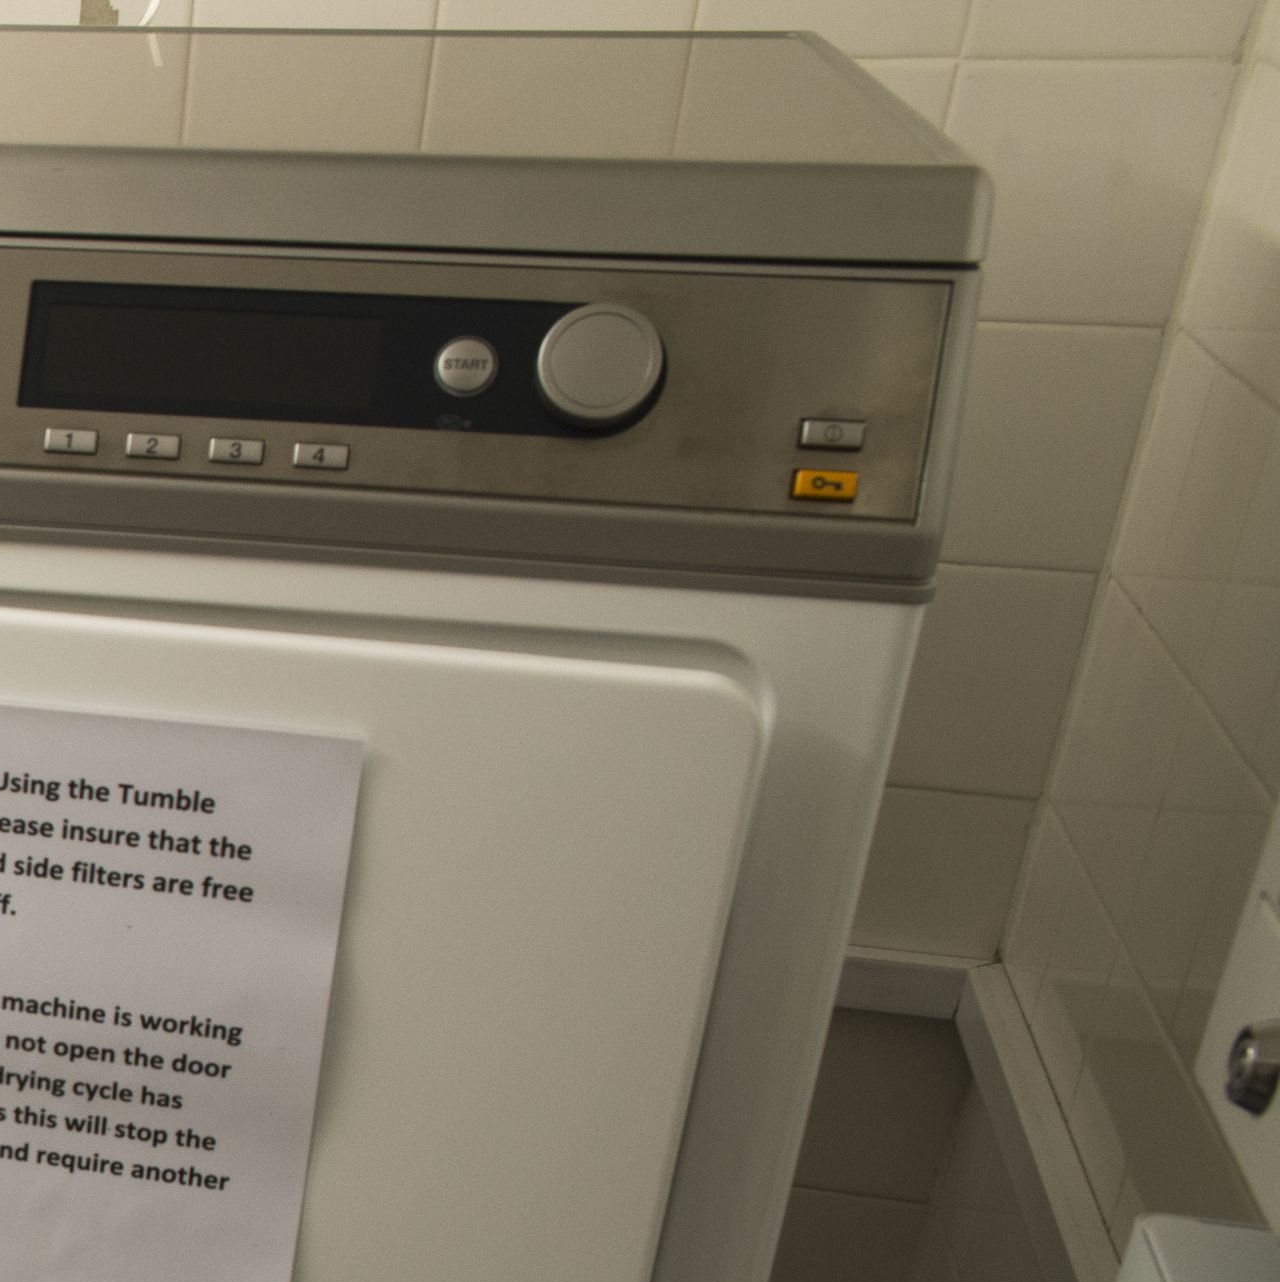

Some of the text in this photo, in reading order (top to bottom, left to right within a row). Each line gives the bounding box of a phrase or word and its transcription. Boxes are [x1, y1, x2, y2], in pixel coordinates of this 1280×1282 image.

[444, 358, 488, 371] START
[64, 433, 324, 464] 1 2 3 4
[68, 778, 110, 802] the
[118, 783, 216, 814] Tumble
[62, 818, 140, 848] insure
[148, 829, 202, 855] that
[209, 836, 252, 861] the
[14, 856, 64, 881] side
[71, 861, 145, 890] filters
[152, 876, 194, 896] are
[201, 876, 254, 903] free
[1, 996, 106, 1024] machine
[113, 1005, 132, 1027] is
[140, 1014, 243, 1047] working
[5, 1035, 47, 1054] not
[53, 1042, 115, 1063] open
[123, 1047, 164, 1070] the
[171, 1053, 232, 1079] door
[72, 1081, 133, 1103] cycle
[140, 1085, 183, 1110] has
[13, 1105, 57, 1129] this
[64, 1115, 108, 1136] will
[114, 1122, 168, 1148] stop
[175, 1128, 216, 1151] the
[36, 1150, 124, 1176] require
[131, 1164, 230, 1191] another
